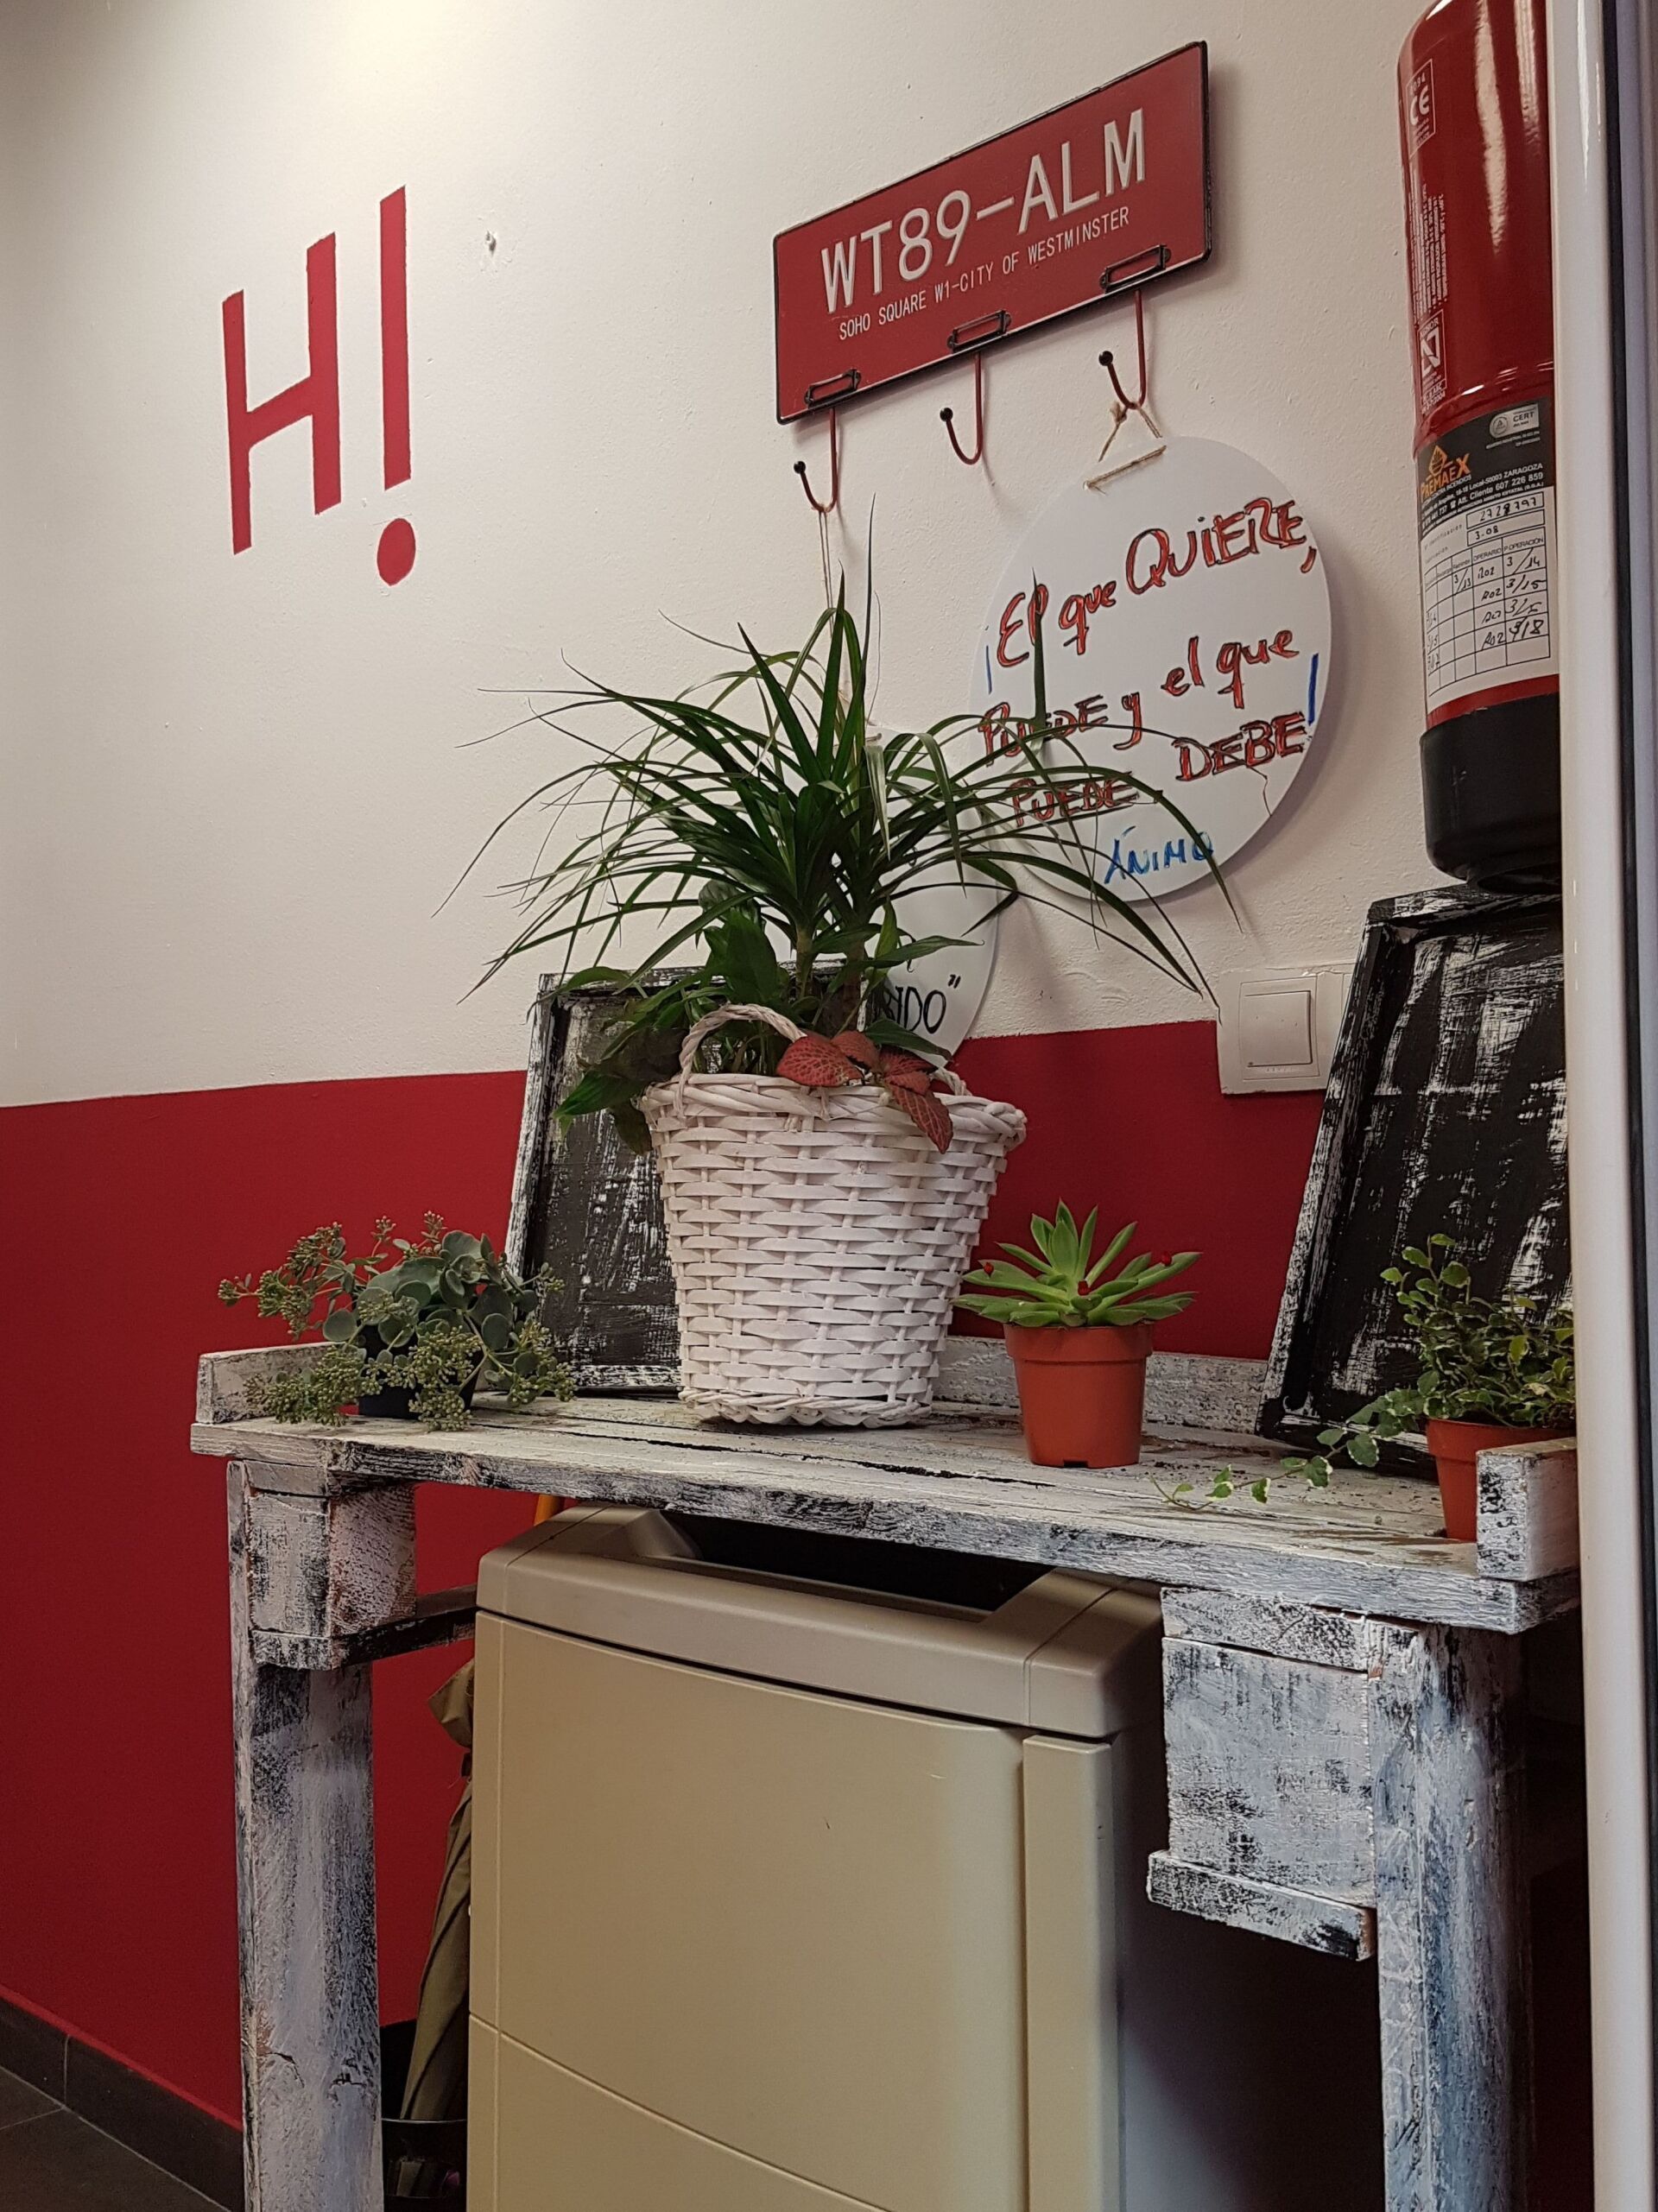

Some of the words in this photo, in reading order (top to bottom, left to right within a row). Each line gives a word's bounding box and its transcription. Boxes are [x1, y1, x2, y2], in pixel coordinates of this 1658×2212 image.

[820, 107, 1146, 314] WT89-ALM
[838, 313, 870, 341] SOHO
[877, 289, 927, 326] SQUARE
[1002, 250, 1020, 275] OF
[1027, 205, 1130, 266] WESTMINSTER
[222, 184, 416, 586] HI!
[1503, 463, 1543, 478] ZARAGOZA
[1058, 579, 1117, 656] que
[1160, 635, 1206, 696] el
[1216, 629, 1300, 710] que
